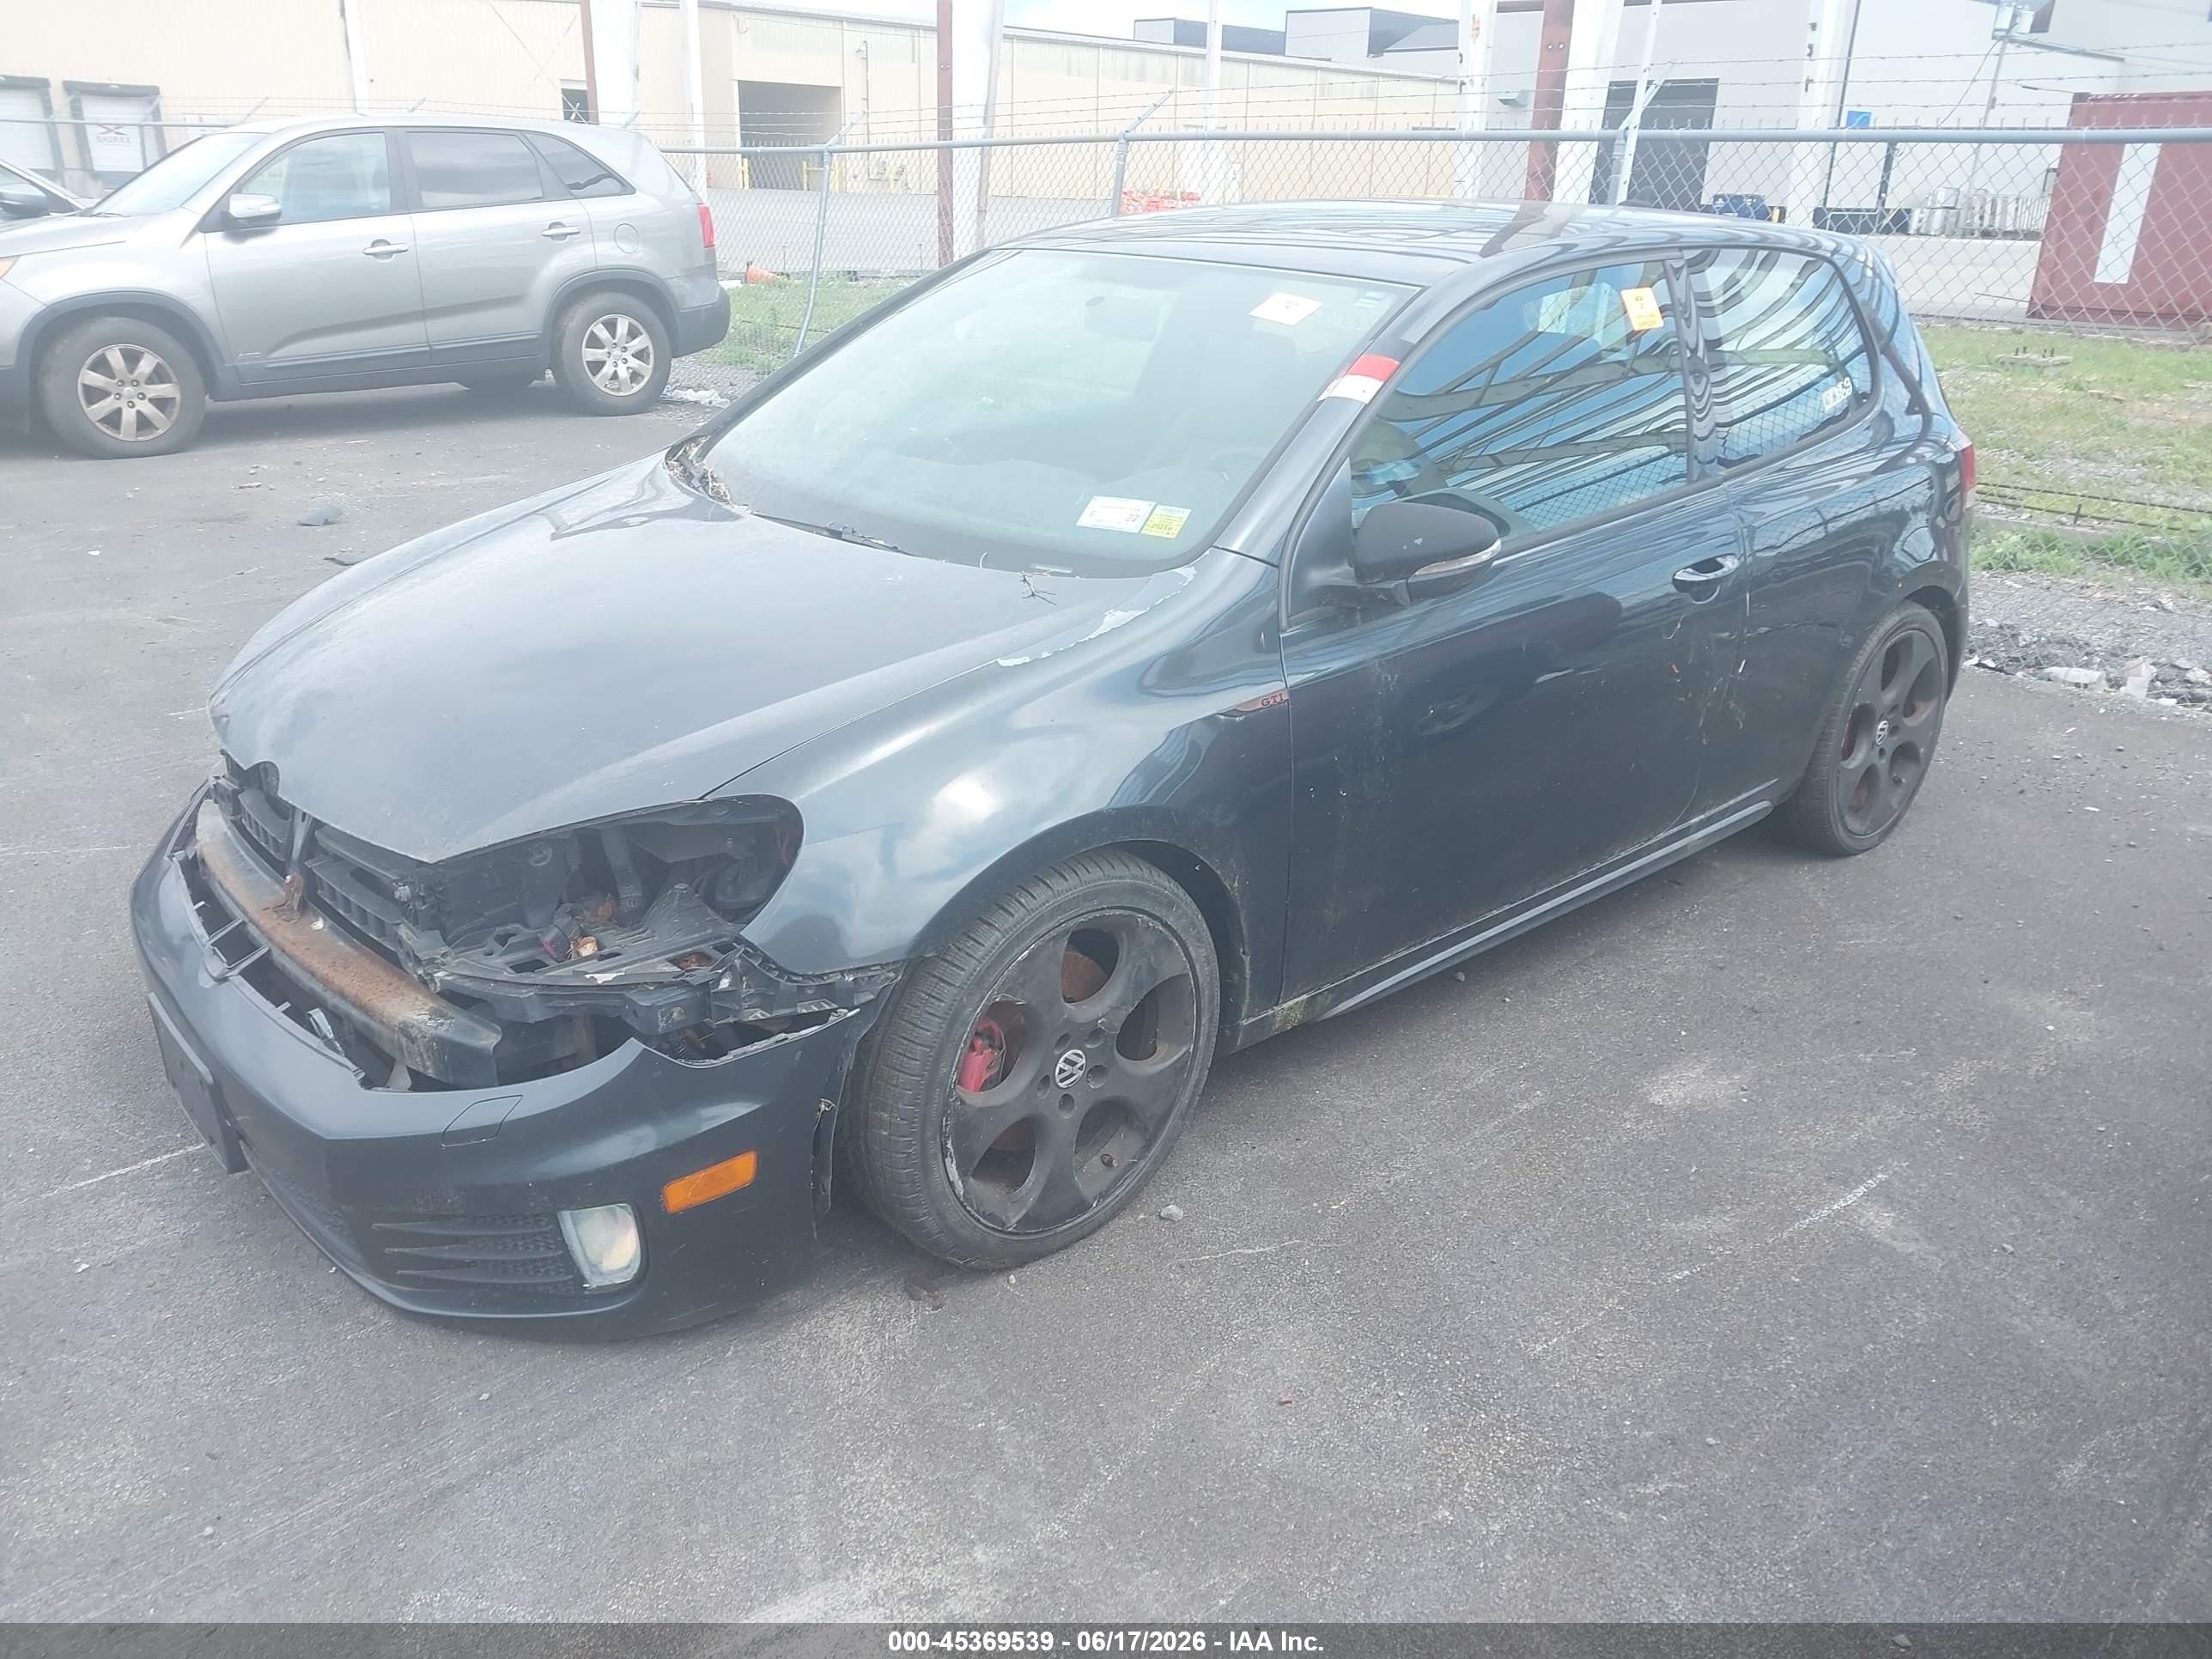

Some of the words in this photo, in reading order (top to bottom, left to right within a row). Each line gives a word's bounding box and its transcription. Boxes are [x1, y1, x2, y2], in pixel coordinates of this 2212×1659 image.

[1126, 514, 1140, 523] 22
[1262, 694, 1283, 706] GTI
[1055, 1049, 1085, 1088] VW
